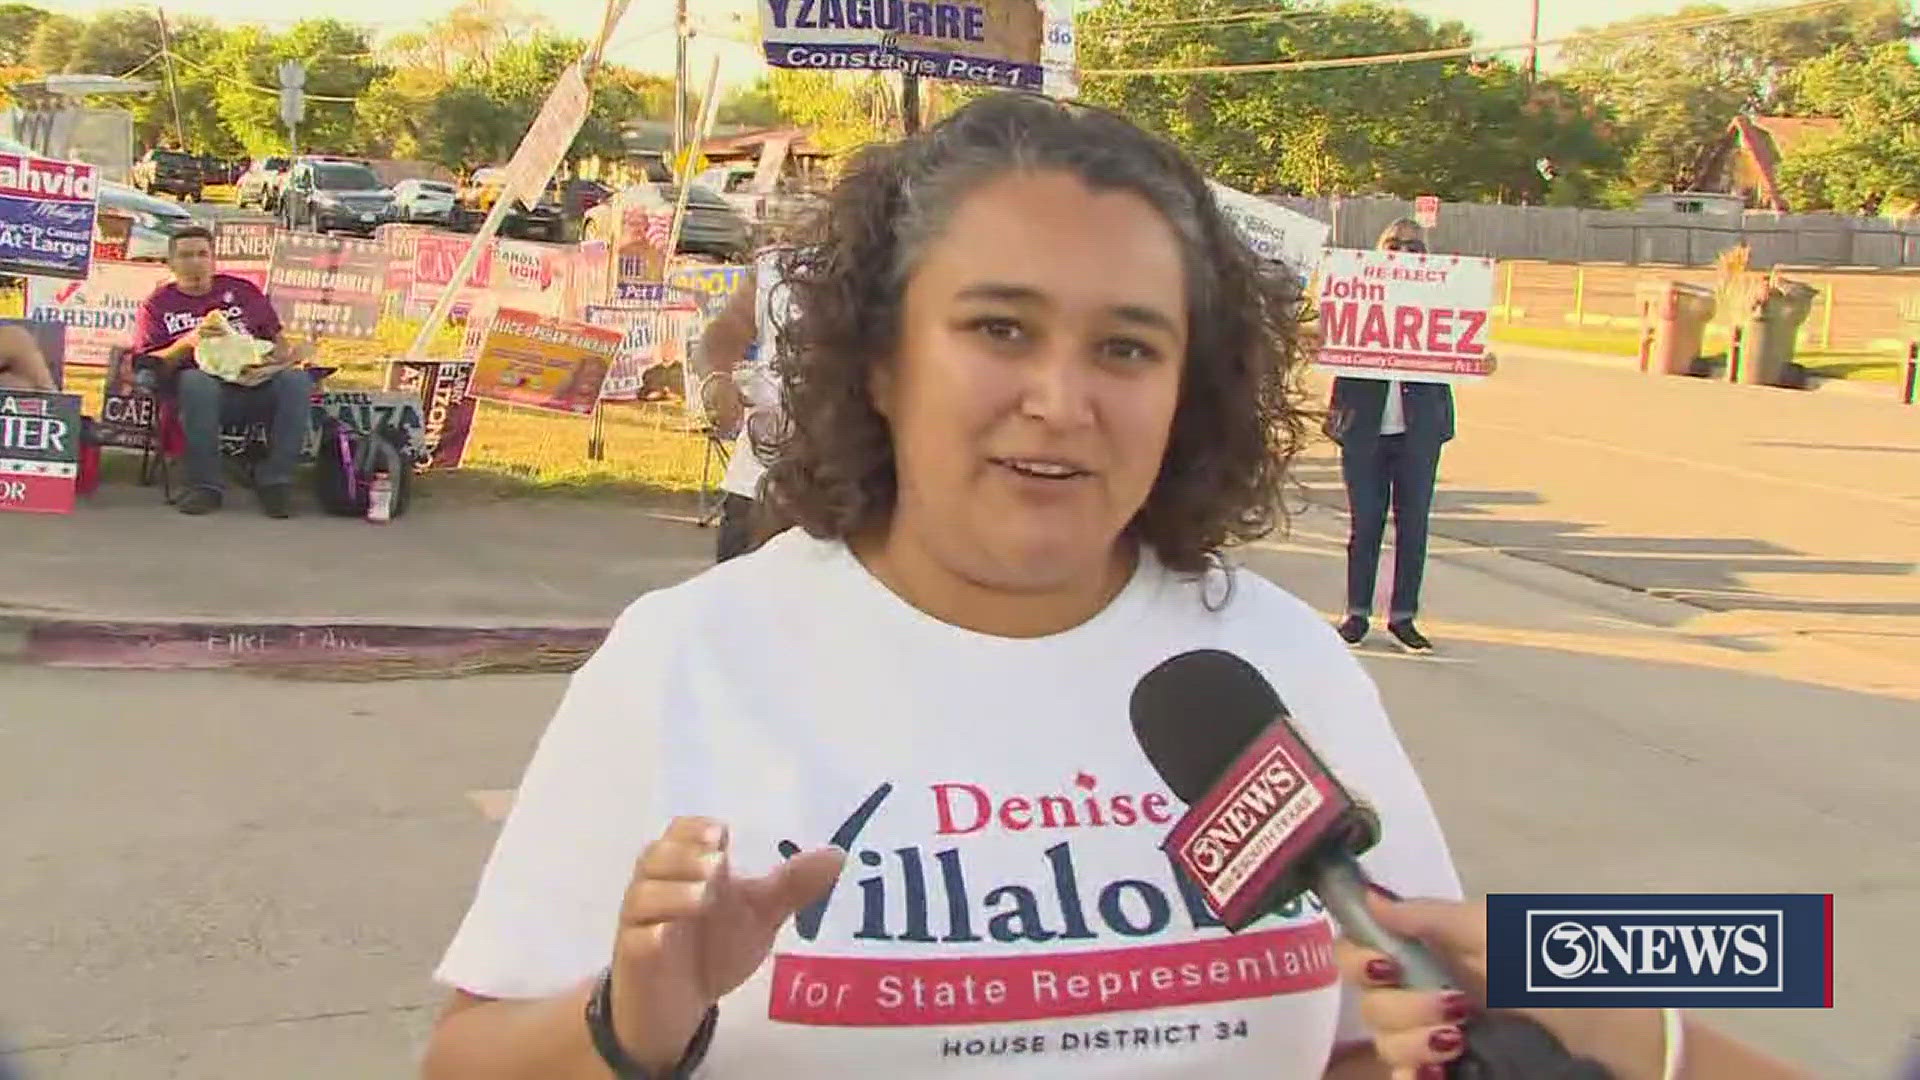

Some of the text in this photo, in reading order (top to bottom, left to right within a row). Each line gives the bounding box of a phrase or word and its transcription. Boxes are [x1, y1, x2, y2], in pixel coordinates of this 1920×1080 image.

[947, 58, 997, 81] Pct
[1006, 67, 1021, 85] 1
[0, 230, 89, 259] At-Large
[1322, 274, 1385, 301] John
[1320, 301, 1488, 353] MAREZ
[930, 772, 1172, 836] Denise
[789, 971, 850, 1013] for
[876, 973, 1007, 1011] State
[943, 1020, 1249, 1058] HOUSE DISTRICT 34
